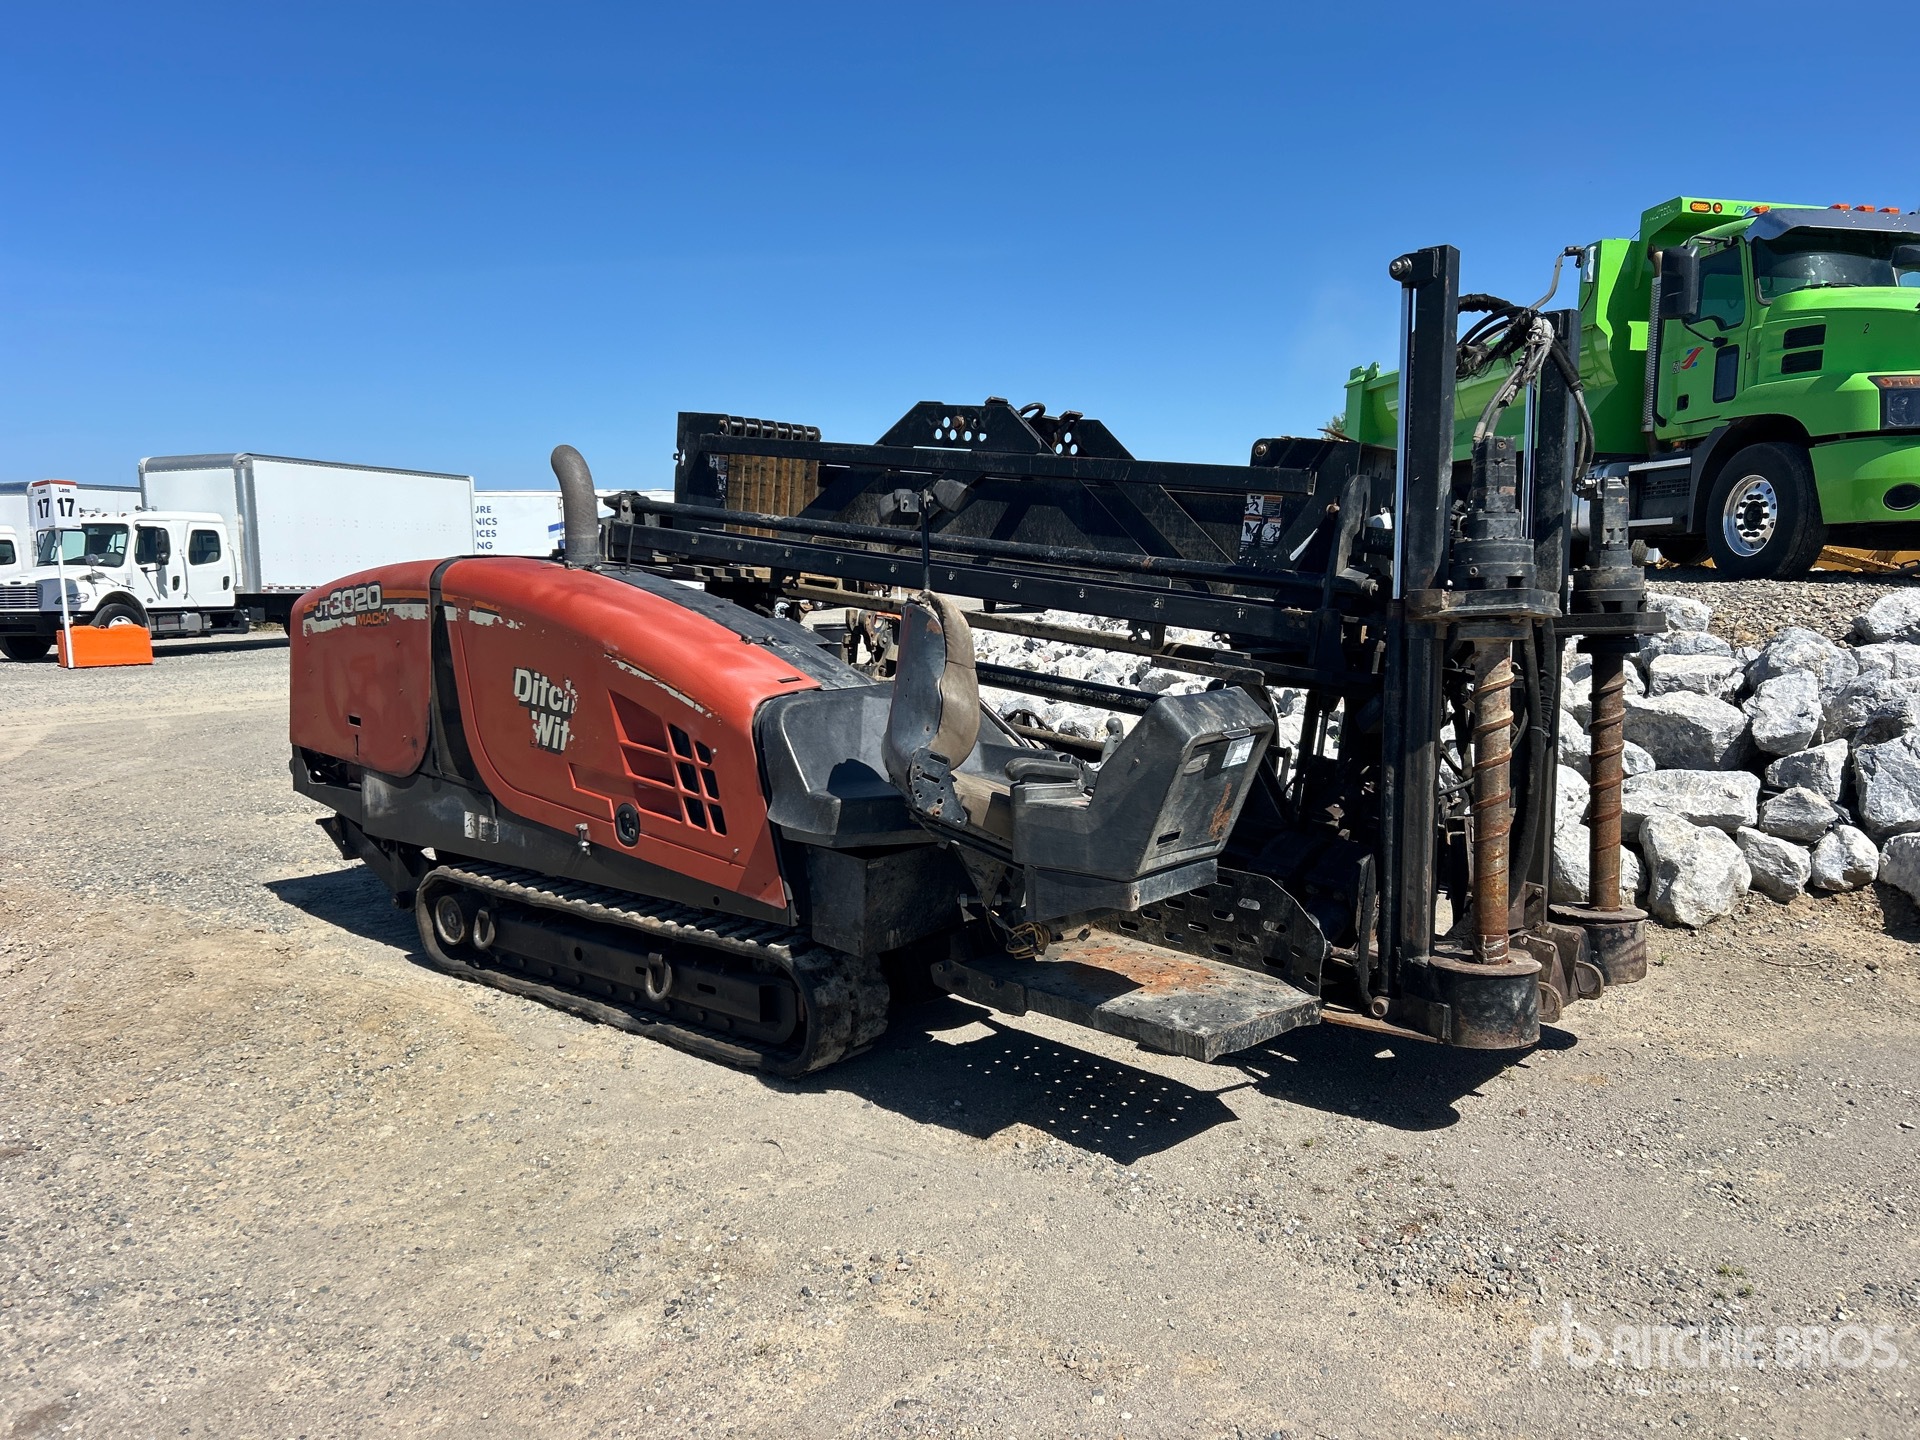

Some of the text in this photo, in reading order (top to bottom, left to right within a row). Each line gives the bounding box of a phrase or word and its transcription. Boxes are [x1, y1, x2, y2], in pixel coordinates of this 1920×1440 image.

[1863, 322, 1870, 334] 2
[37, 498, 50, 518] 17
[57, 497, 75, 517] 17
[315, 584, 381, 618] JT3020
[357, 611, 387, 626] MACH
